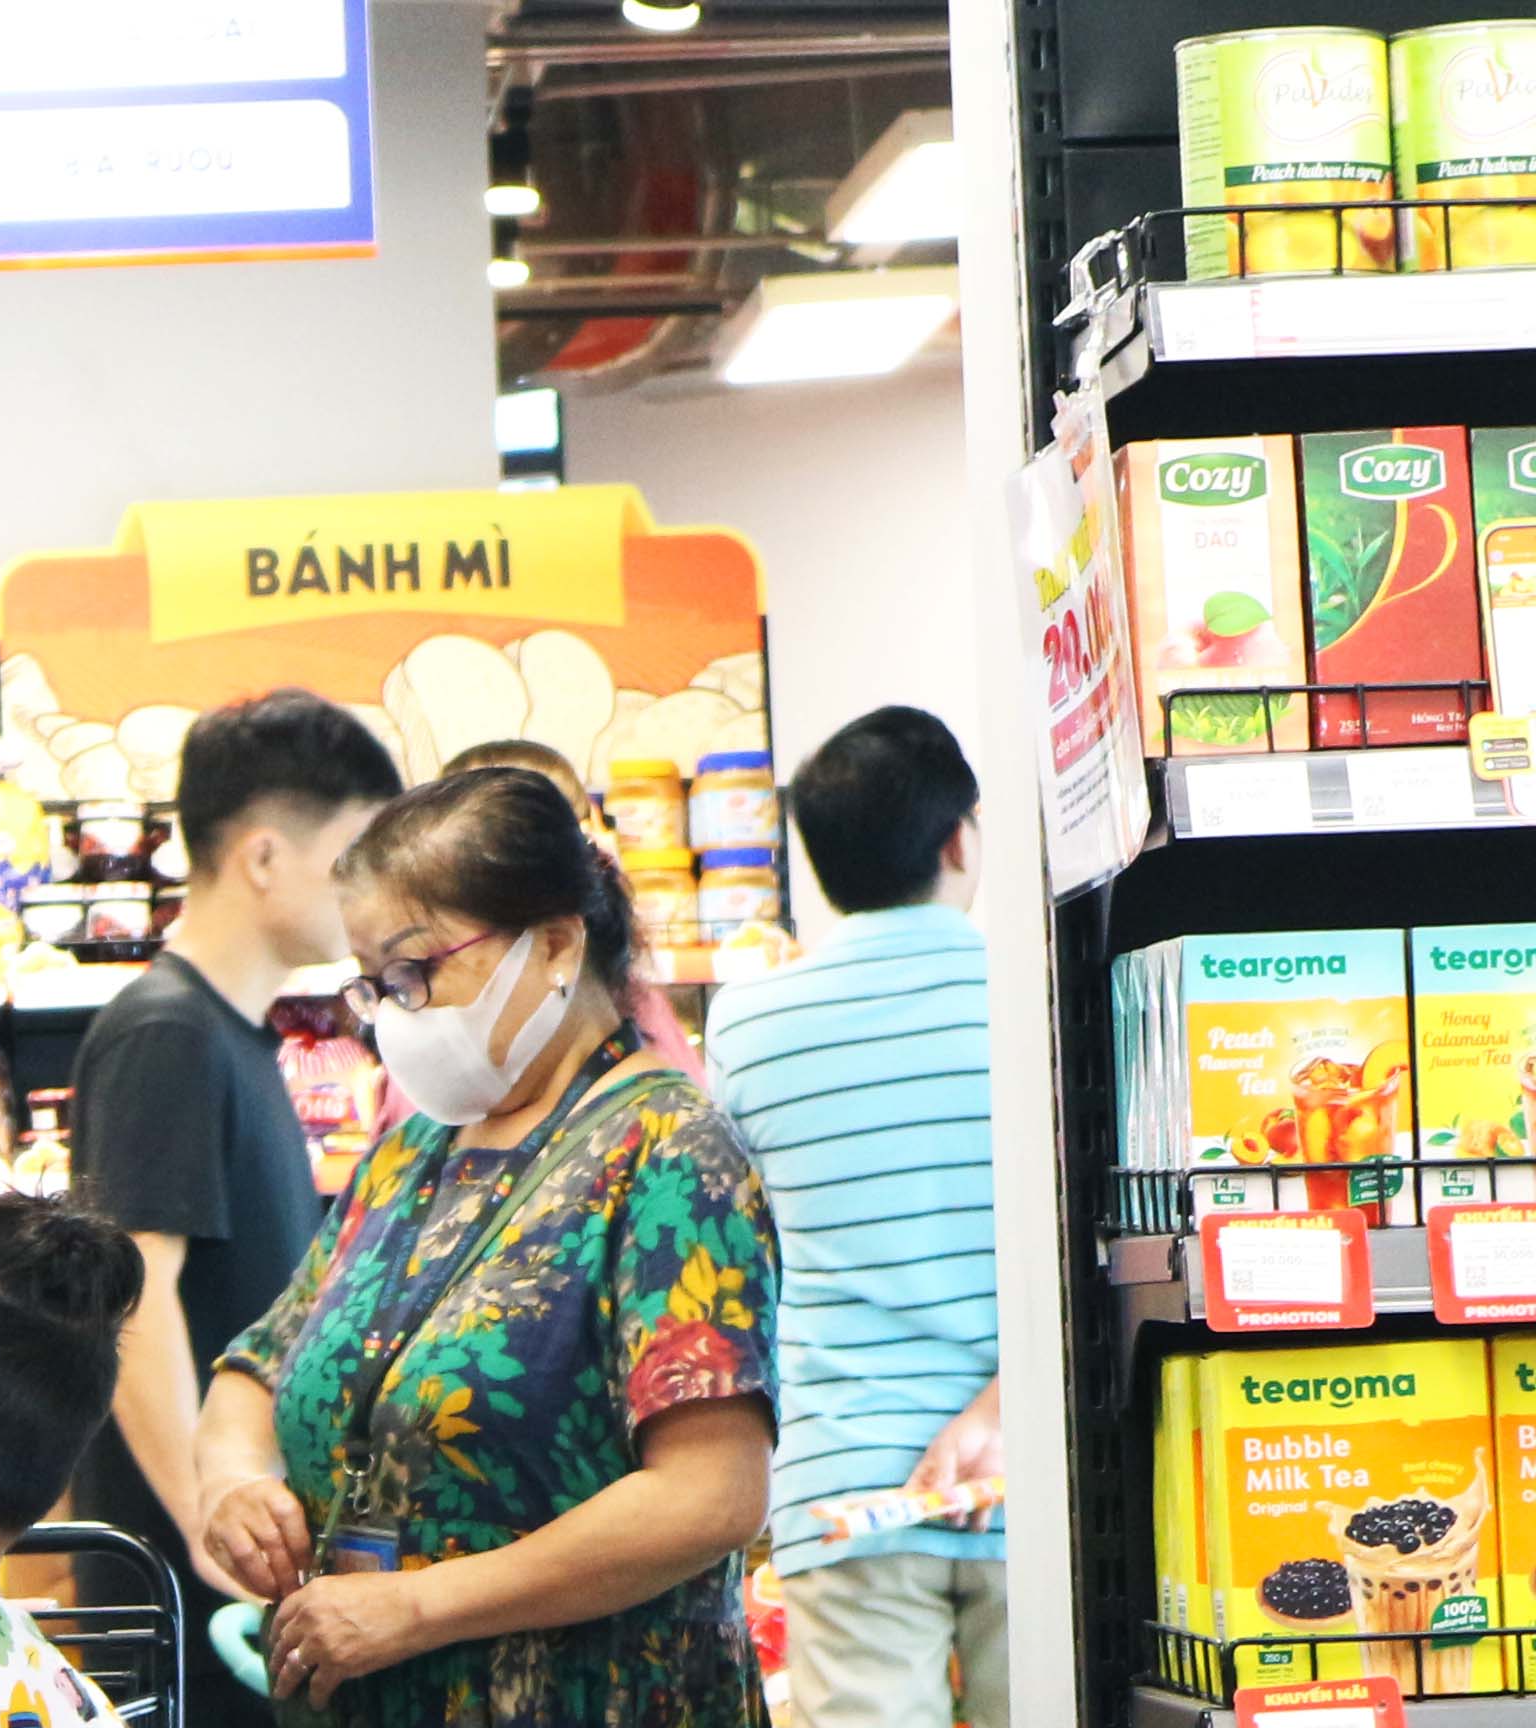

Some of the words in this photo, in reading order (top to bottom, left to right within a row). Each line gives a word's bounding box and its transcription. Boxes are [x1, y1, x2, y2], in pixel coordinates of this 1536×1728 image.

[1252, 163, 1294, 183] Peach
[1295, 161, 1340, 179] halves
[1438, 161, 1479, 178] Peach
[1165, 463, 1254, 499] Cozy
[1352, 455, 1435, 489] Cozy
[247, 530, 420, 600] BÁNH
[439, 523, 513, 591] MÌ
[1200, 951, 1347, 982] tearoma
[1440, 1011, 1491, 1030] Honey
[1207, 1026, 1276, 1050] Peach
[1422, 1030, 1511, 1048] Calamansi
[1198, 1055, 1264, 1071] flavored
[1483, 1049, 1512, 1066] Tea
[1237, 1072, 1277, 1096] Tea
[1212, 1176, 1230, 1191] 14
[1441, 1170, 1459, 1185] 14
[1238, 1310, 1341, 1326] PROMOTION
[1241, 1373, 1416, 1408] tearoma
[1243, 1432, 1351, 1462] Bubble
[1246, 1468, 1311, 1493] Milk
[1318, 1464, 1370, 1489] Tea
[1247, 1500, 1308, 1517] Original
[1443, 1598, 1483, 1618] 100%
[1264, 1686, 1334, 1707] KHUYẾN
[1336, 1685, 1369, 1701] MÃI
